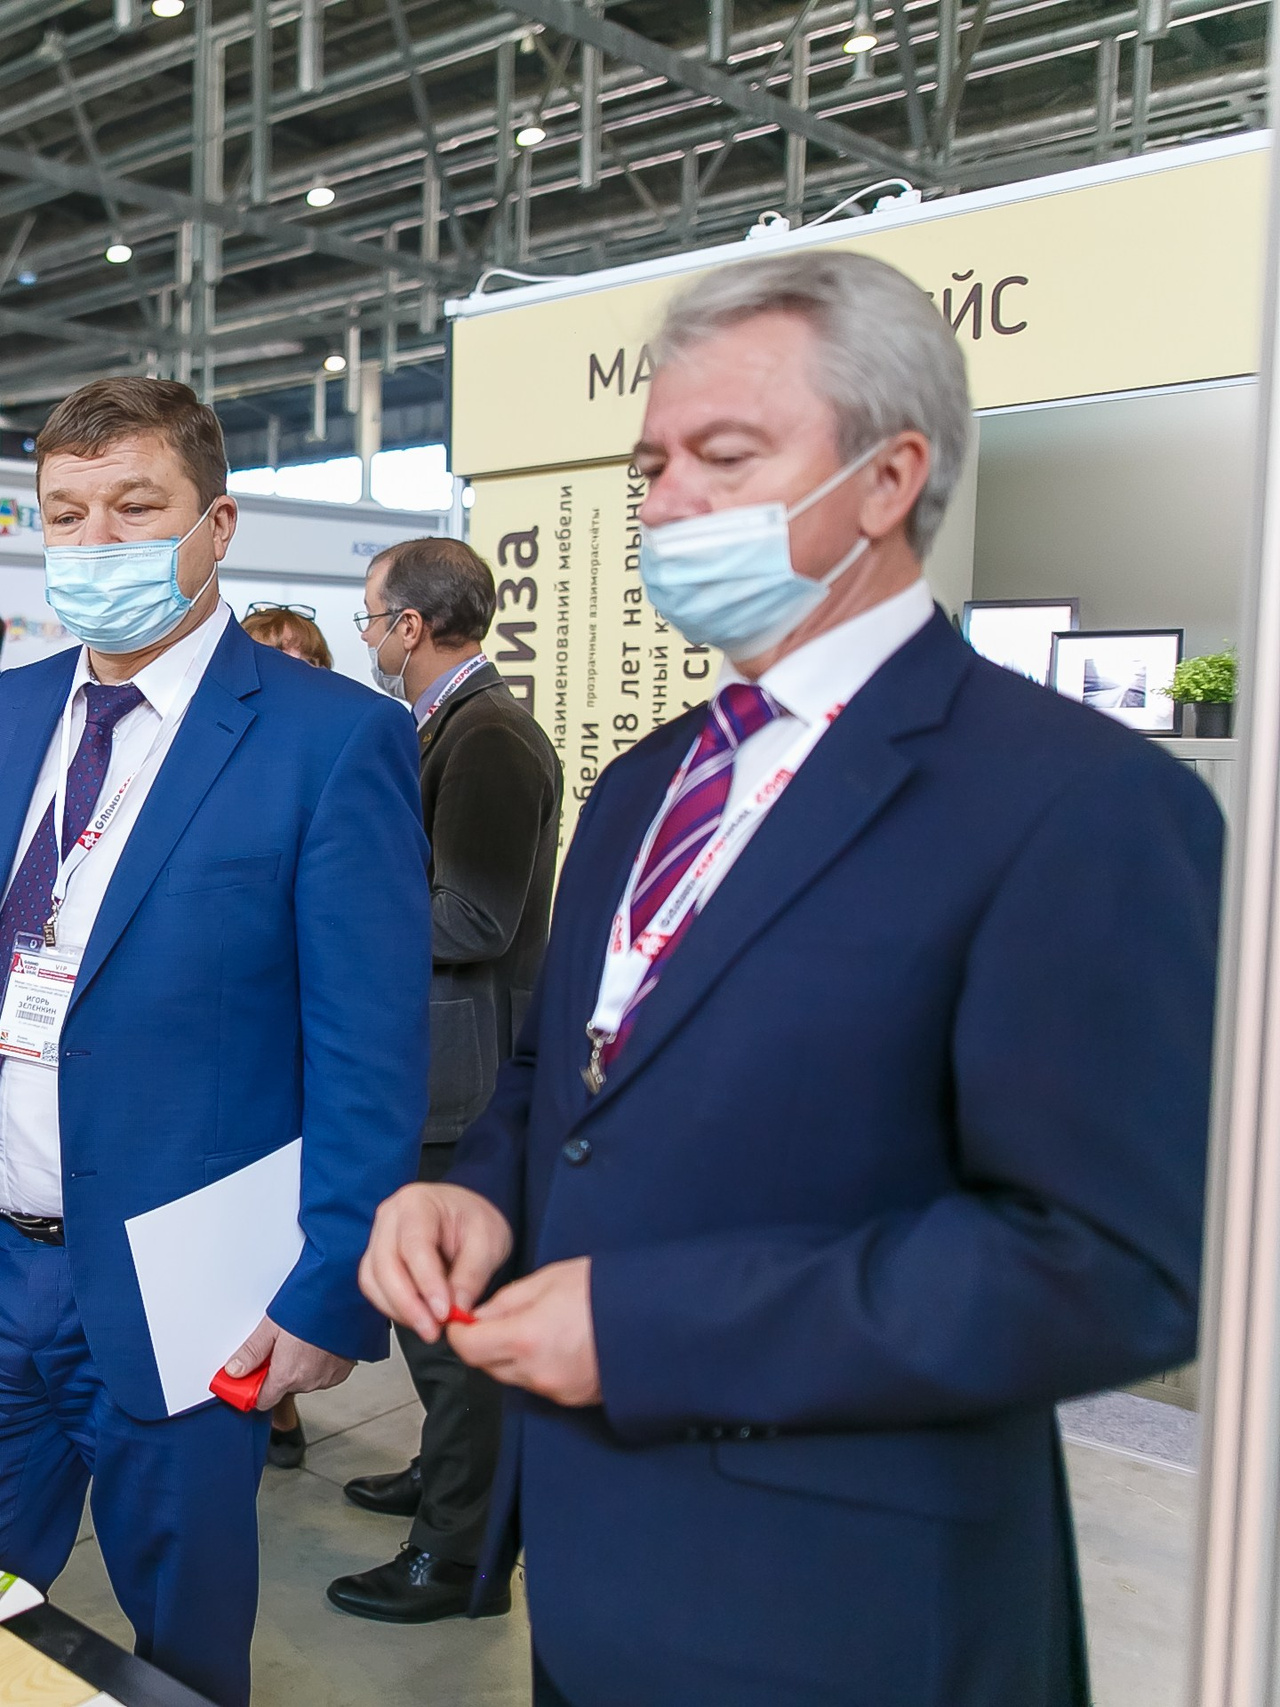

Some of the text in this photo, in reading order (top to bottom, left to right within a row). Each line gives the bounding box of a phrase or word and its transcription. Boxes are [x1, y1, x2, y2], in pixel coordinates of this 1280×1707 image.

[930, 269, 1029, 340] ЙС
[555, 485, 572, 570] мебели
[496, 525, 540, 717] шиза
[587, 508, 601, 708] прозрачные взаиморасчёты
[623, 586, 642, 627] на
[438, 654, 487, 705] GRANDEXPOURAL.CO
[553, 580, 571, 749] наименований
[621, 642, 641, 699] лет
[648, 646, 668, 730] ичный
[612, 713, 639, 752] 18
[573, 722, 599, 815] бели
[18, 1001, 57, 1015] ЗЕЛЕНКИН
[26, 995, 50, 1006] ИГОРЬ
